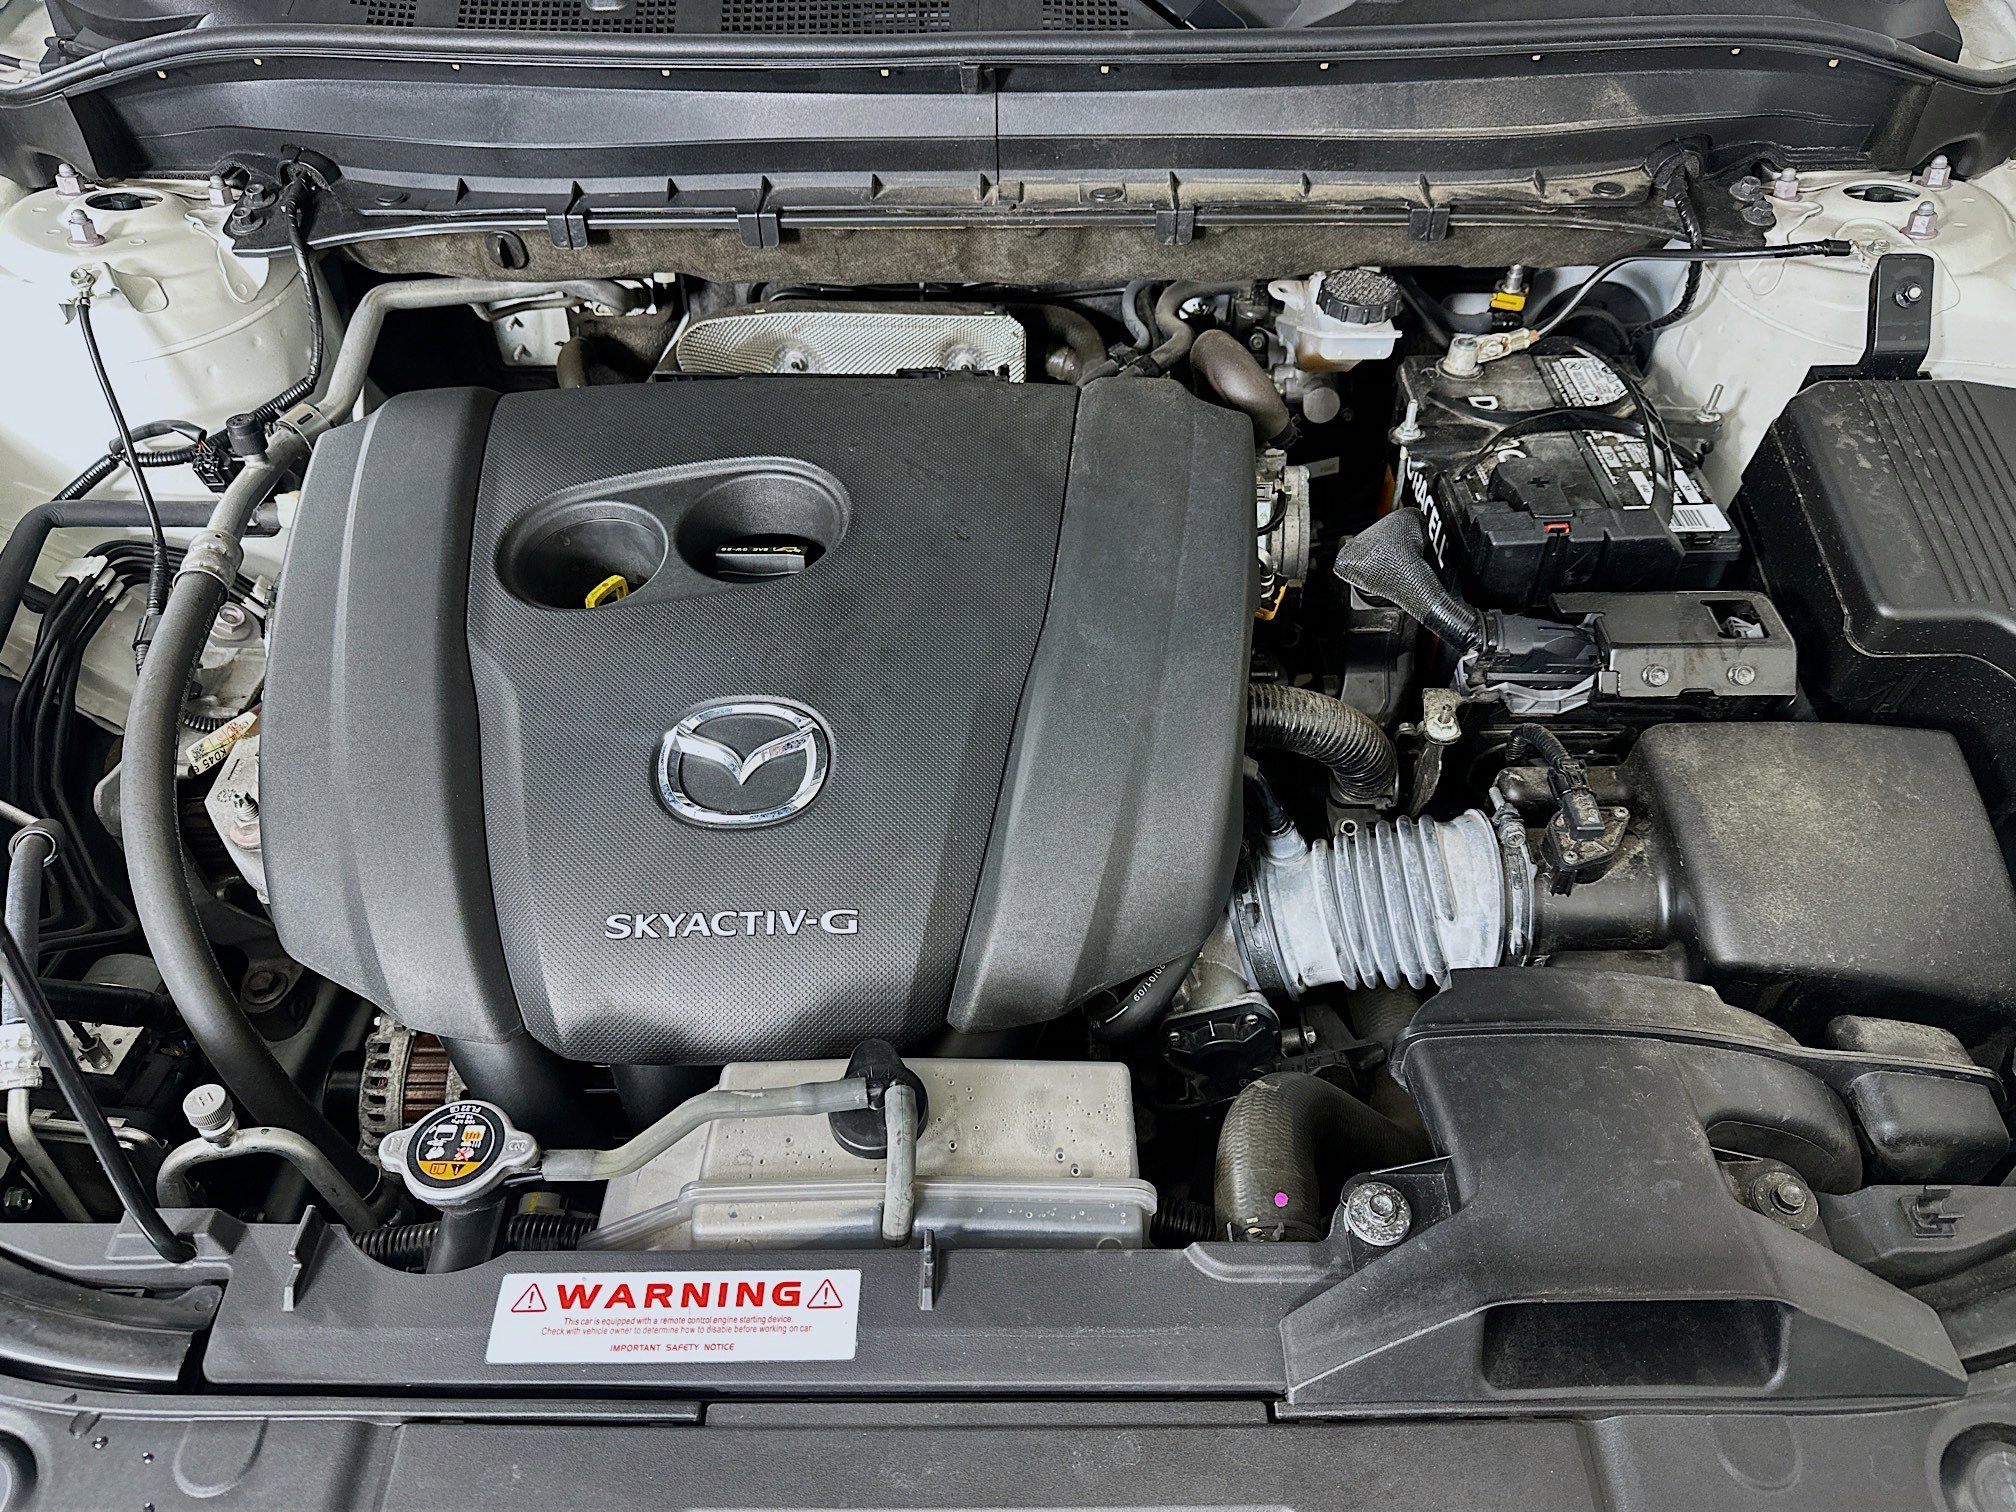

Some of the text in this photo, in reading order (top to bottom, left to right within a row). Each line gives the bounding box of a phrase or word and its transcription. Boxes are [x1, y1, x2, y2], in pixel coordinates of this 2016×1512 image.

[1406, 457, 1447, 569] URACELL
[604, 909, 860, 940] SKYACTIV-G
[557, 1281, 802, 1309] WARNING
[541, 1327, 565, 1336] Check
[566, 1327, 581, 1335] with
[583, 1327, 608, 1335] vehicle
[610, 1327, 632, 1335] owner
[642, 1326, 679, 1335] determine
[680, 1326, 695, 1334] how
[697, 1326, 705, 1334] to
[706, 1325, 732, 1334] disable
[734, 1325, 757, 1333] before
[759, 1325, 787, 1335] working
[789, 1325, 798, 1333] on
[564, 1317, 579, 1326] This
[580, 1318, 593, 1326] car
[593, 1317, 600, 1325] is
[601, 1317, 635, 1327] equipped
[636, 1316, 652, 1325] with
[660, 1317, 686, 1325] remote
[687, 1316, 712, 1325] control
[713, 1316, 738, 1325] engine
[739, 1315, 766, 1325] starting
[610, 1343, 735, 1352] IMPORTANT SAFETY NOTICE
